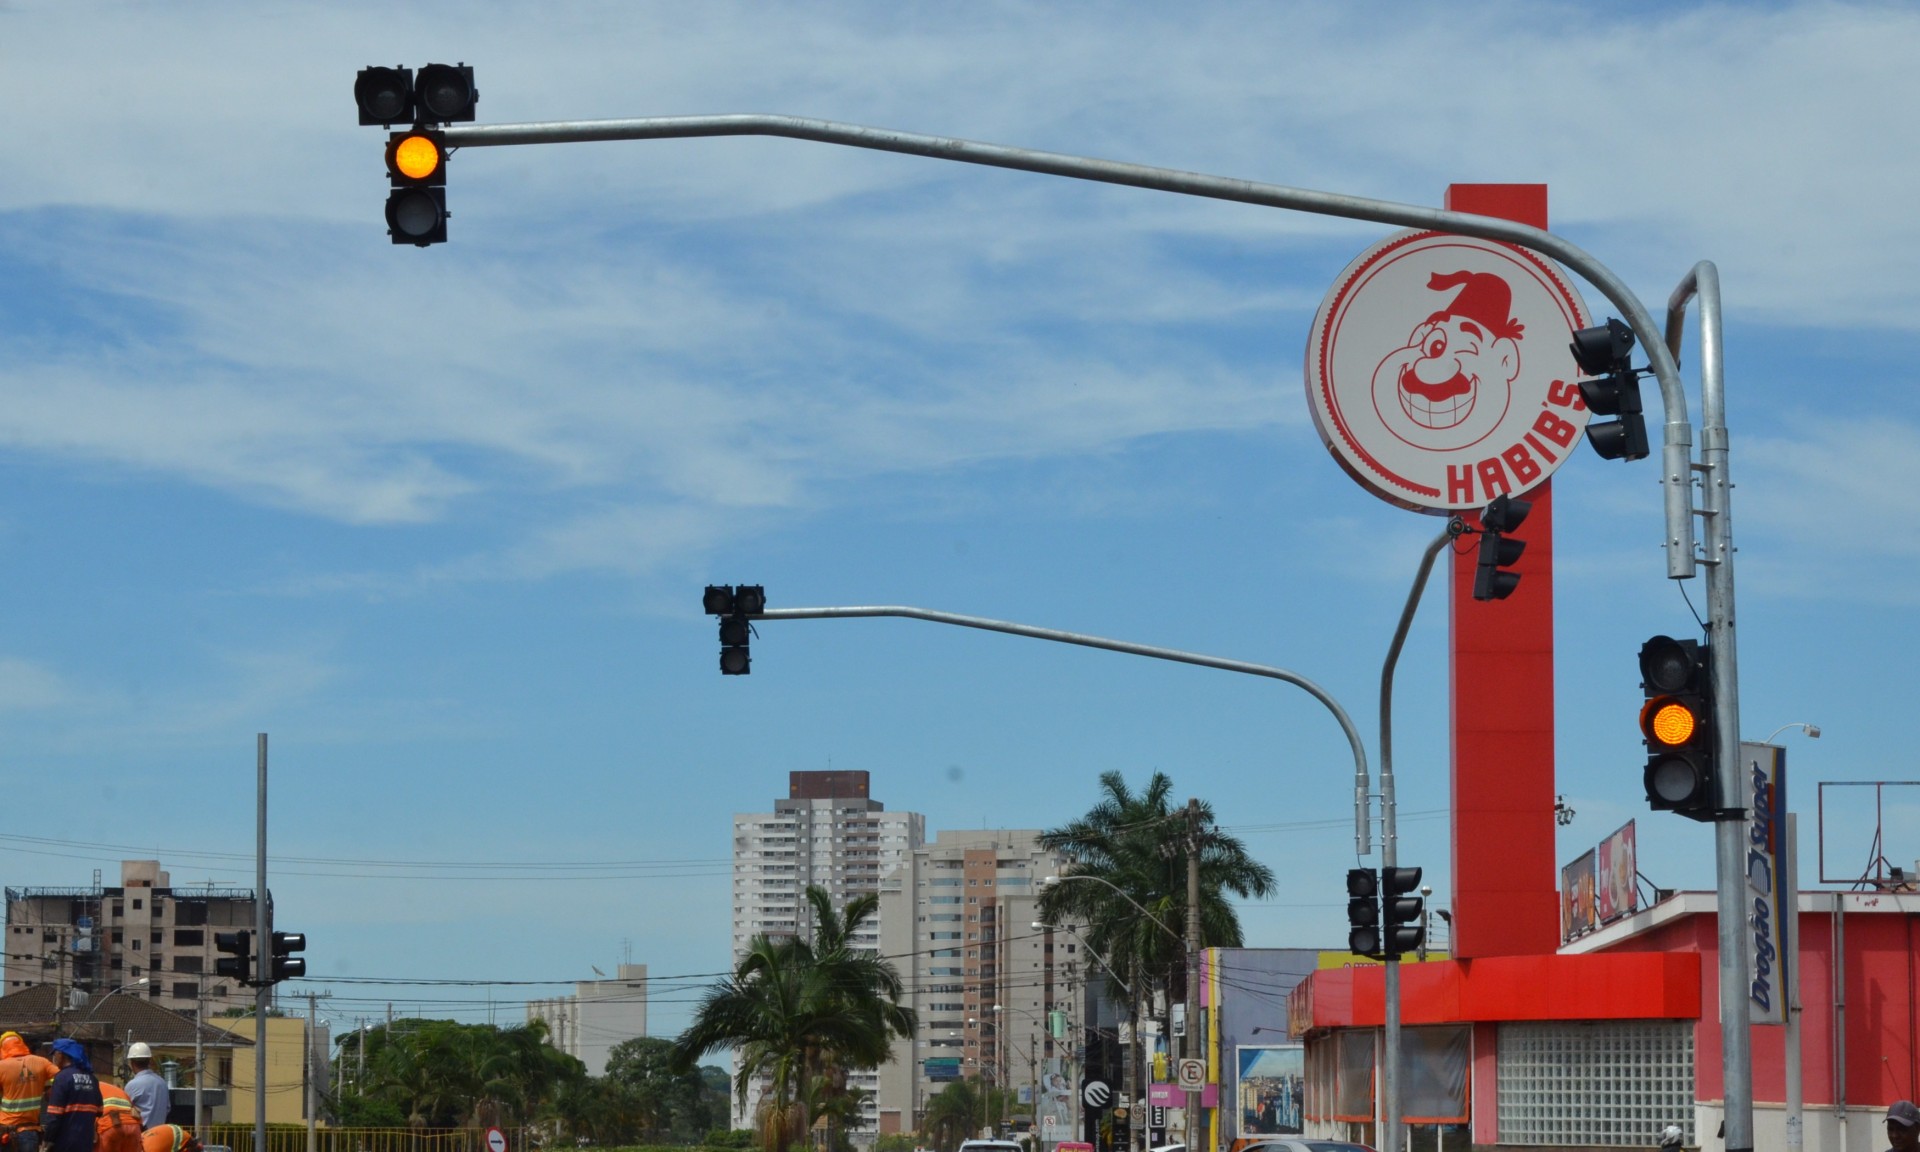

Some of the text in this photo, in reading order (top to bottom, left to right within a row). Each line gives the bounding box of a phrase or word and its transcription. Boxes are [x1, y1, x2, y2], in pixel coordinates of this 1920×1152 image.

[1446, 379, 1587, 504] HABIB'S
[1749, 760, 1776, 1012] Drogão Super
